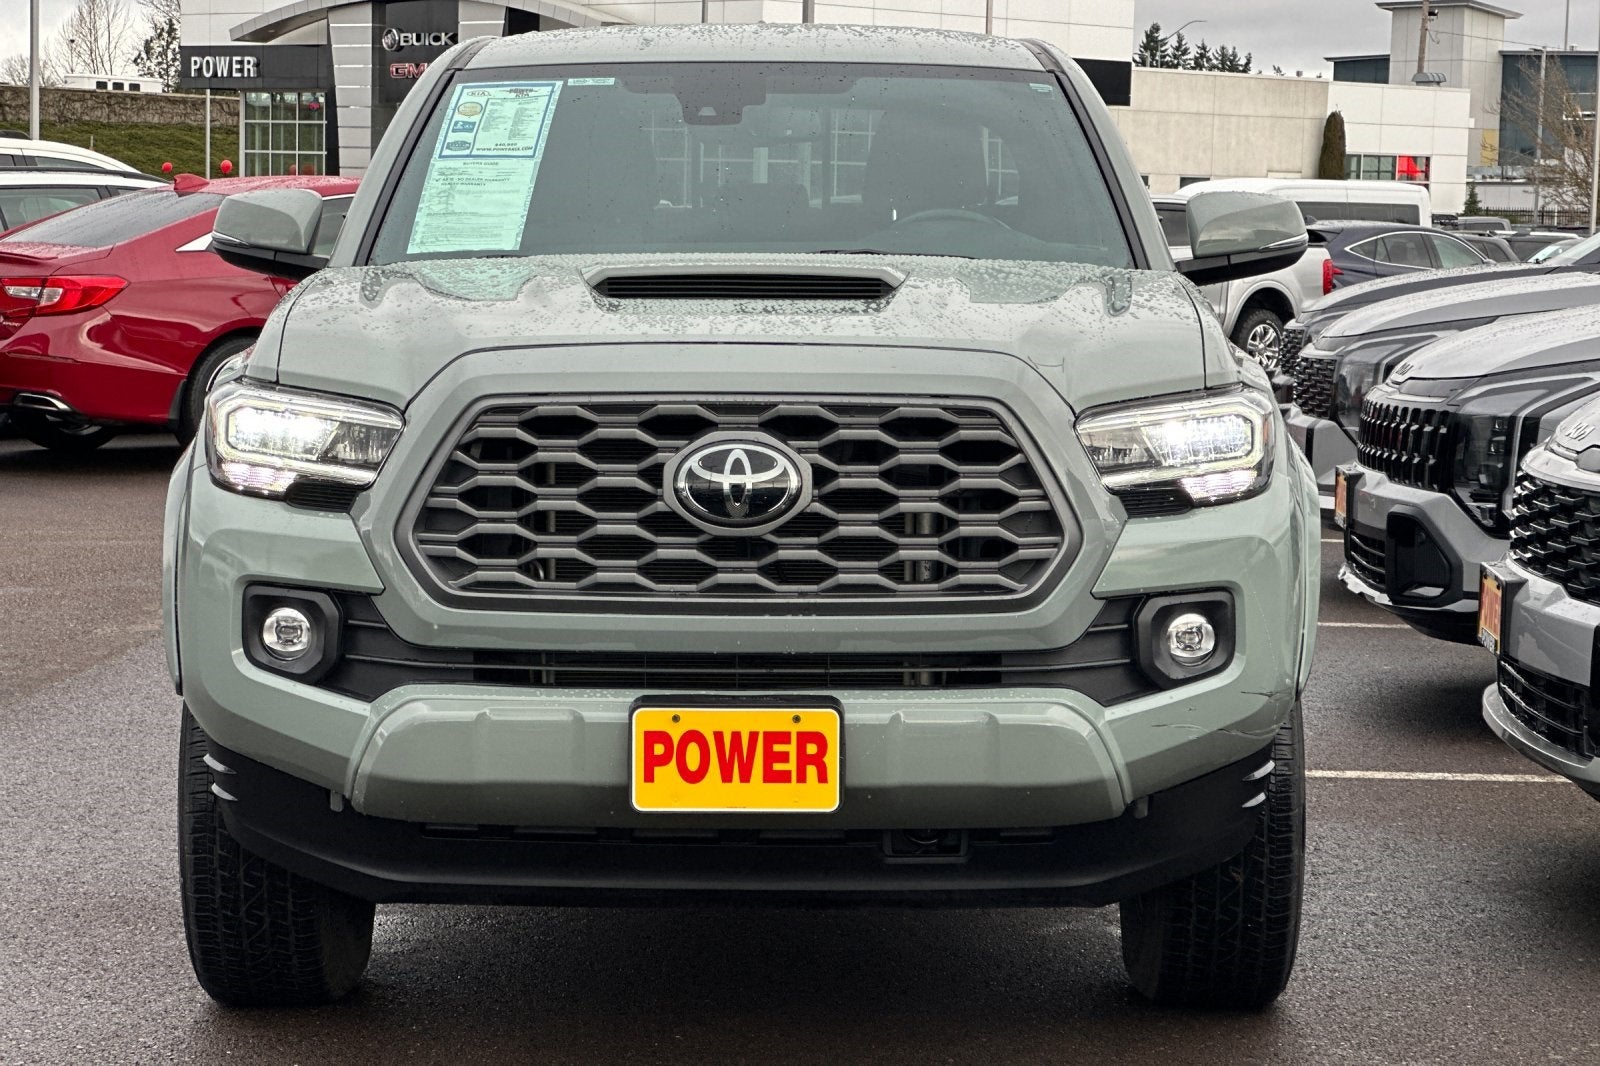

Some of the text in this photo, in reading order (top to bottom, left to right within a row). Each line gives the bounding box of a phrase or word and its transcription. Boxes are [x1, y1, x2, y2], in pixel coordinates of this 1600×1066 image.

[400, 32, 454, 46] BUICK
[190, 56, 258, 78] POWER
[390, 62, 428, 78] GM
[643, 730, 828, 784] POWER
